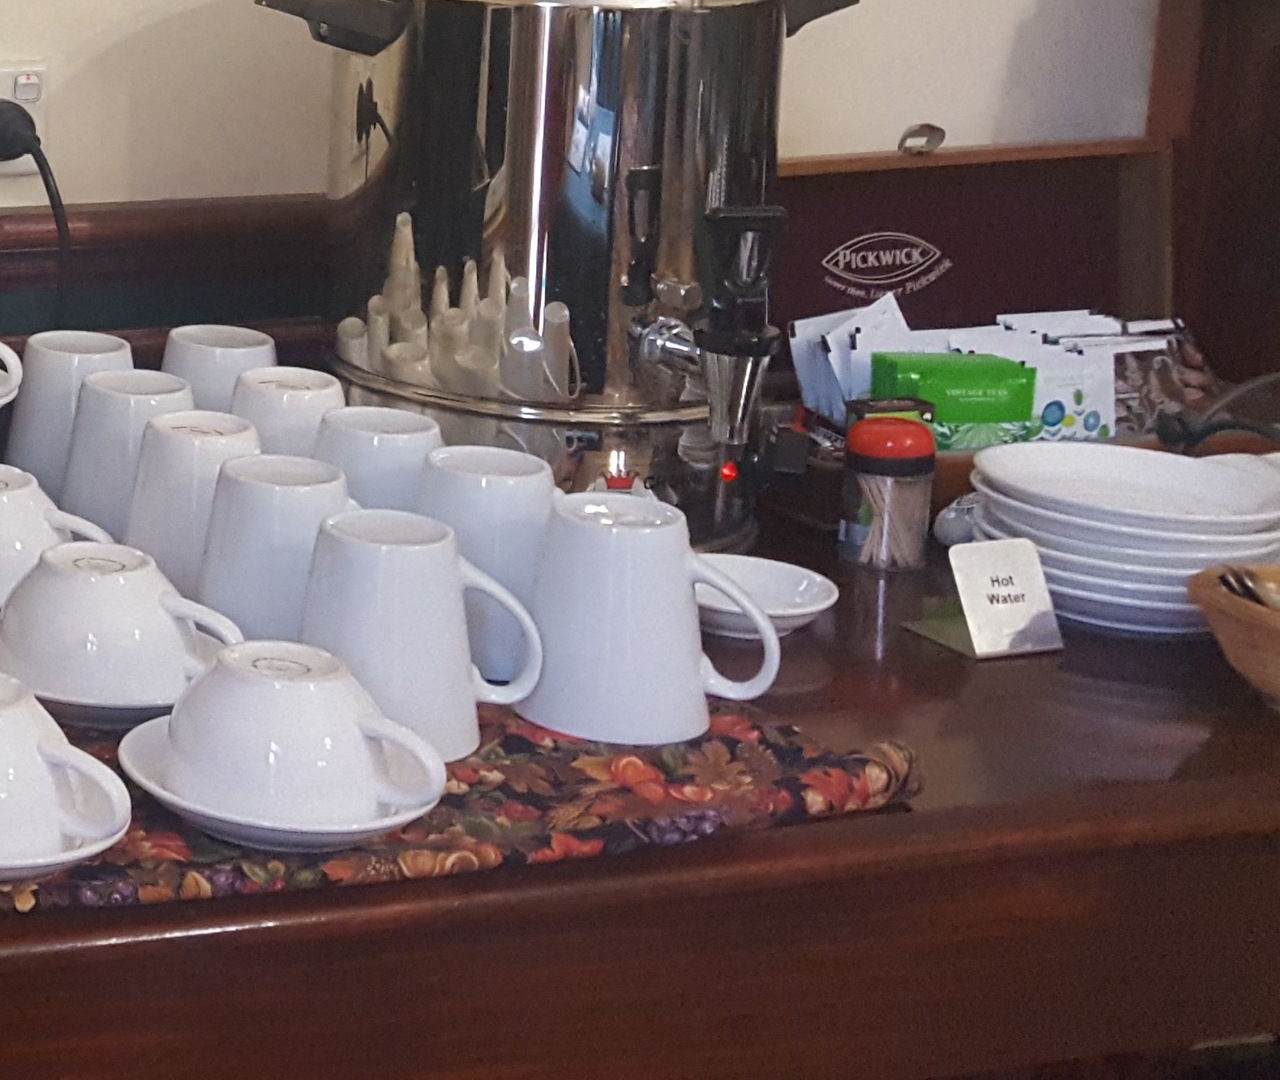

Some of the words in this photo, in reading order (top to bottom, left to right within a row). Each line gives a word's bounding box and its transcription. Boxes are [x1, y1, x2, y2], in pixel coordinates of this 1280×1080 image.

[838, 247, 923, 270] PICKWICK
[990, 575, 1015, 588] Hot
[985, 593, 1026, 605] Water
